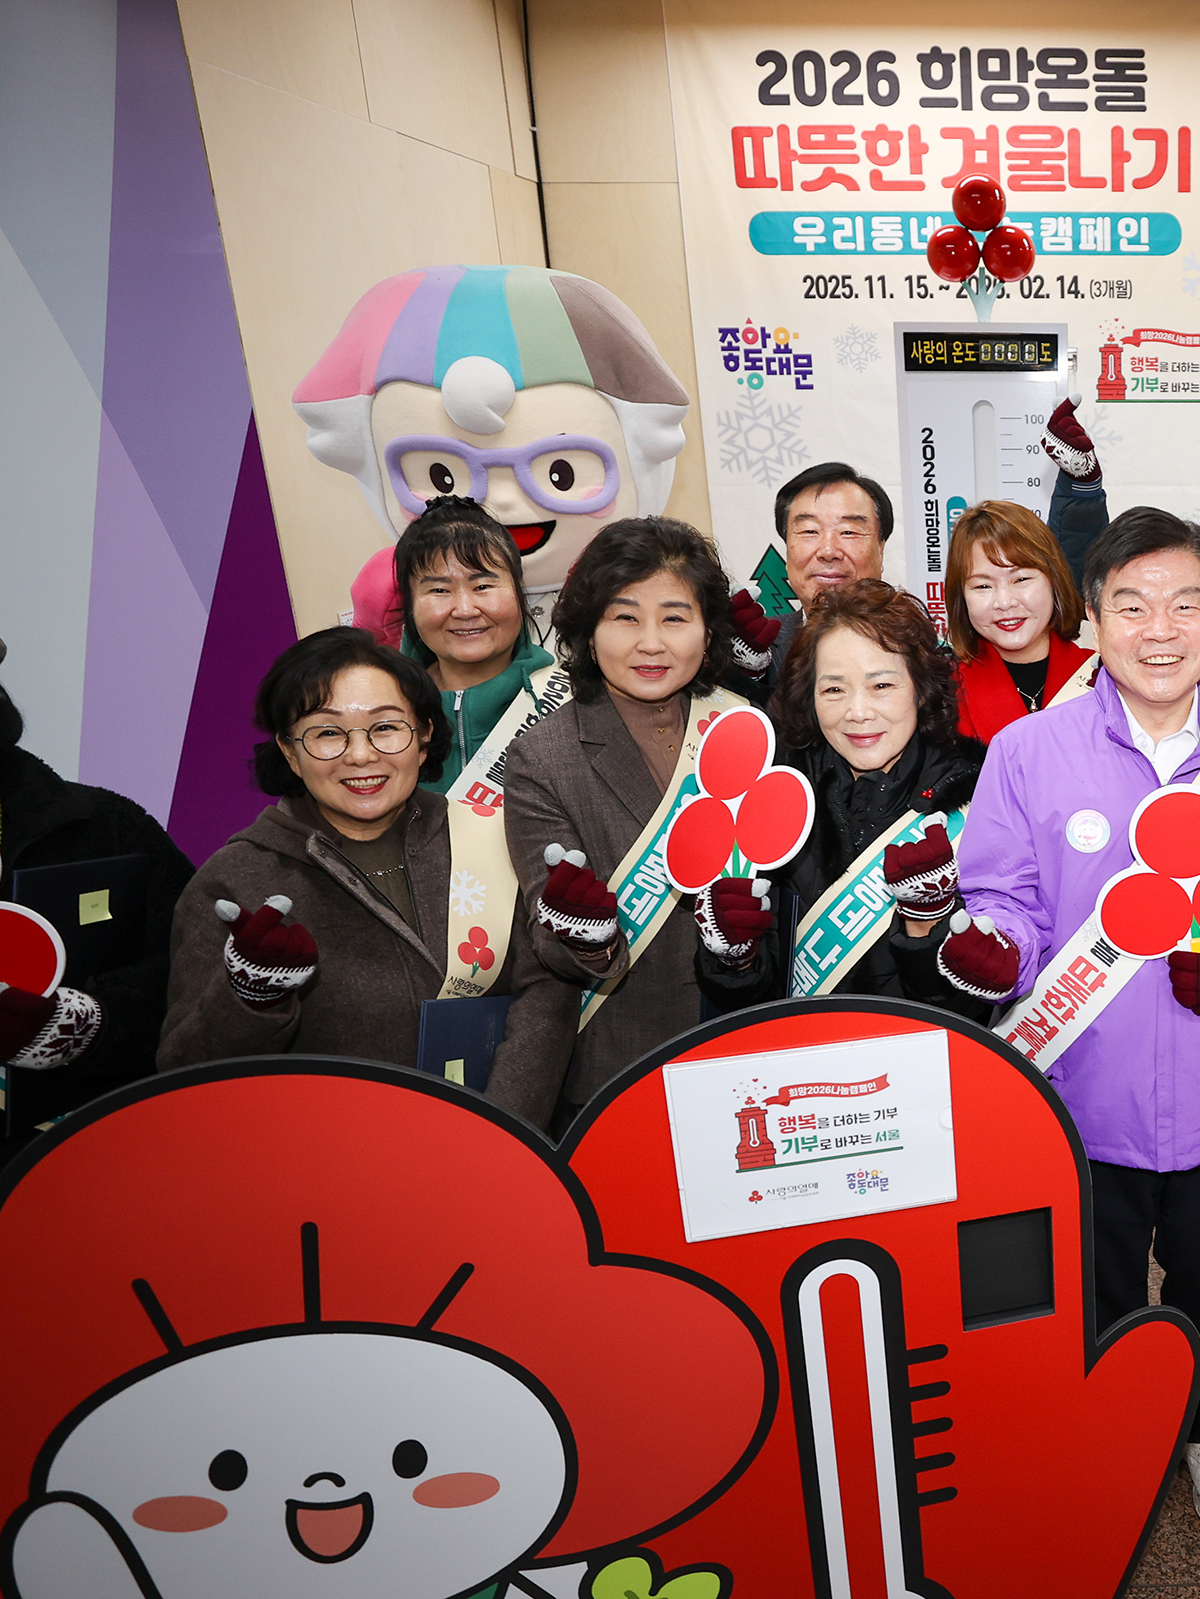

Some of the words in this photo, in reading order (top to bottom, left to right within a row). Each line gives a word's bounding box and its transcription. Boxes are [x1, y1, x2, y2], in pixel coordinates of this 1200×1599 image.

[756, 48, 901, 107] 2026
[915, 45, 1148, 112] 희망온돌
[731, 123, 929, 193] 따뜻한
[939, 123, 1193, 194] 겨울나기
[1003, 216, 1151, 252] 캠페인
[803, 275, 859, 299] 2025.
[865, 275, 893, 299] 11.
[1019, 275, 1050, 299] 02.
[1056, 275, 1085, 299] 14.
[1089, 279, 1133, 299] (3개월)
[911, 340, 947, 364] 사랑의
[952, 341, 976, 364] 온도
[1130, 356, 1168, 373] 행복을
[1172, 361, 1199, 373] 더하는
[1131, 377, 1168, 392] 기부로
[1171, 382, 1199, 393] 바꾸는
[1025, 414, 1044, 424] 100
[921, 427, 937, 494] 2026
[1026, 445, 1040, 454] 90
[1027, 477, 1041, 487] 80
[924, 499, 941, 572] 희망온돌
[787, 1081, 878, 1097] 희망2026나눔캠페인
[777, 1113, 830, 1134] 행복을
[833, 1112, 870, 1127] 더하는
[873, 1107, 898, 1122] 기부
[781, 1135, 832, 1156] 기부로
[835, 1133, 873, 1149] 바꾸는
[875, 1129, 900, 1144] 서울
[765, 1182, 819, 1197] 사랑의열매
